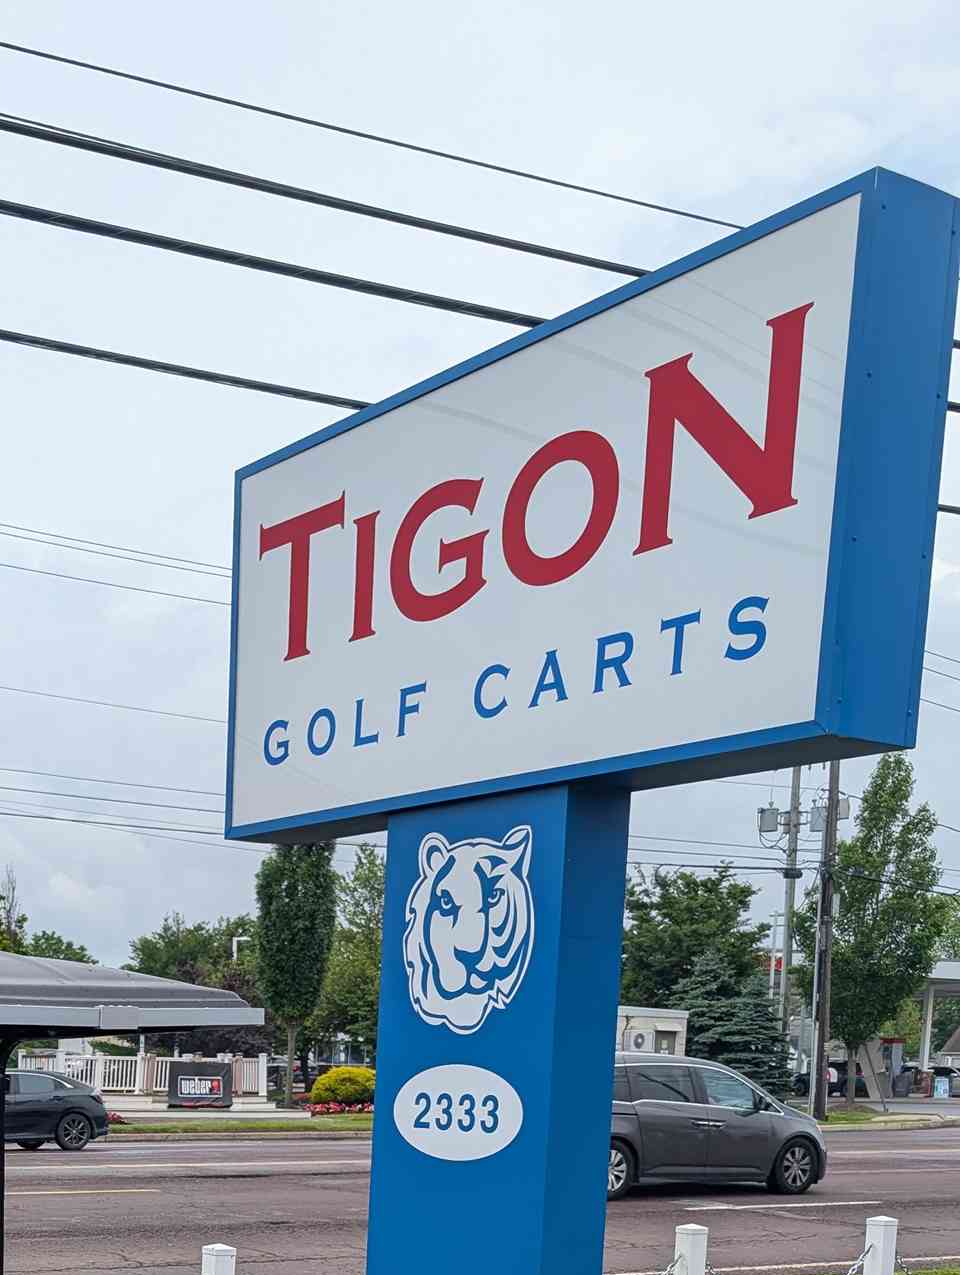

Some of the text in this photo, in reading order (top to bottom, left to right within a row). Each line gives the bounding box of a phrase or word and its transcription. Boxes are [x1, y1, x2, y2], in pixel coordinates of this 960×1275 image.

[260, 302, 814, 661] TIGON
[263, 595, 769, 766] GOLF CARTS
[414, 1092, 499, 1134] 2333
